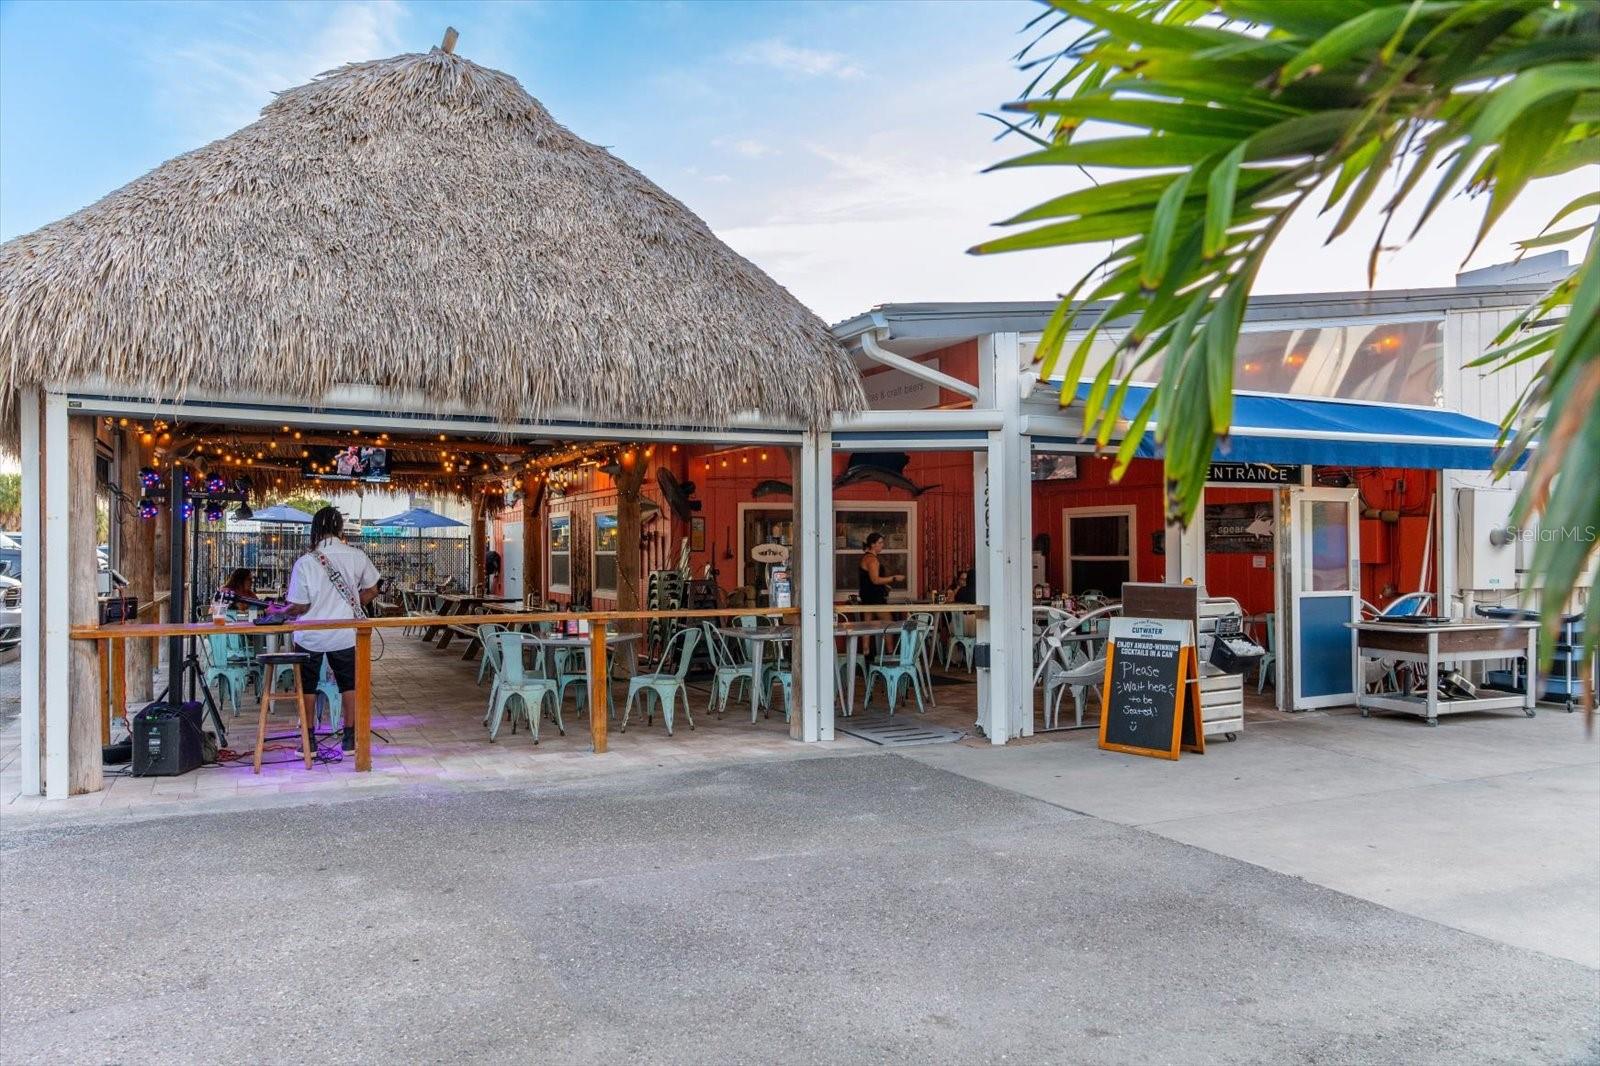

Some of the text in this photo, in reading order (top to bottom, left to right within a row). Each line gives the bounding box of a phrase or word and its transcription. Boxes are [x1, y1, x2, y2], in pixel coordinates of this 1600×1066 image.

[1205, 467, 1288, 481] ENTRANCE
[1131, 627, 1163, 635] CUTWATER
[1134, 642, 1179, 651] AWARD-WINNING
[1121, 648, 1149, 656] COCKTAILS
[1120, 661, 1160, 679] Please
[1147, 681, 1167, 693] here
[1128, 694, 1153, 704] to be
